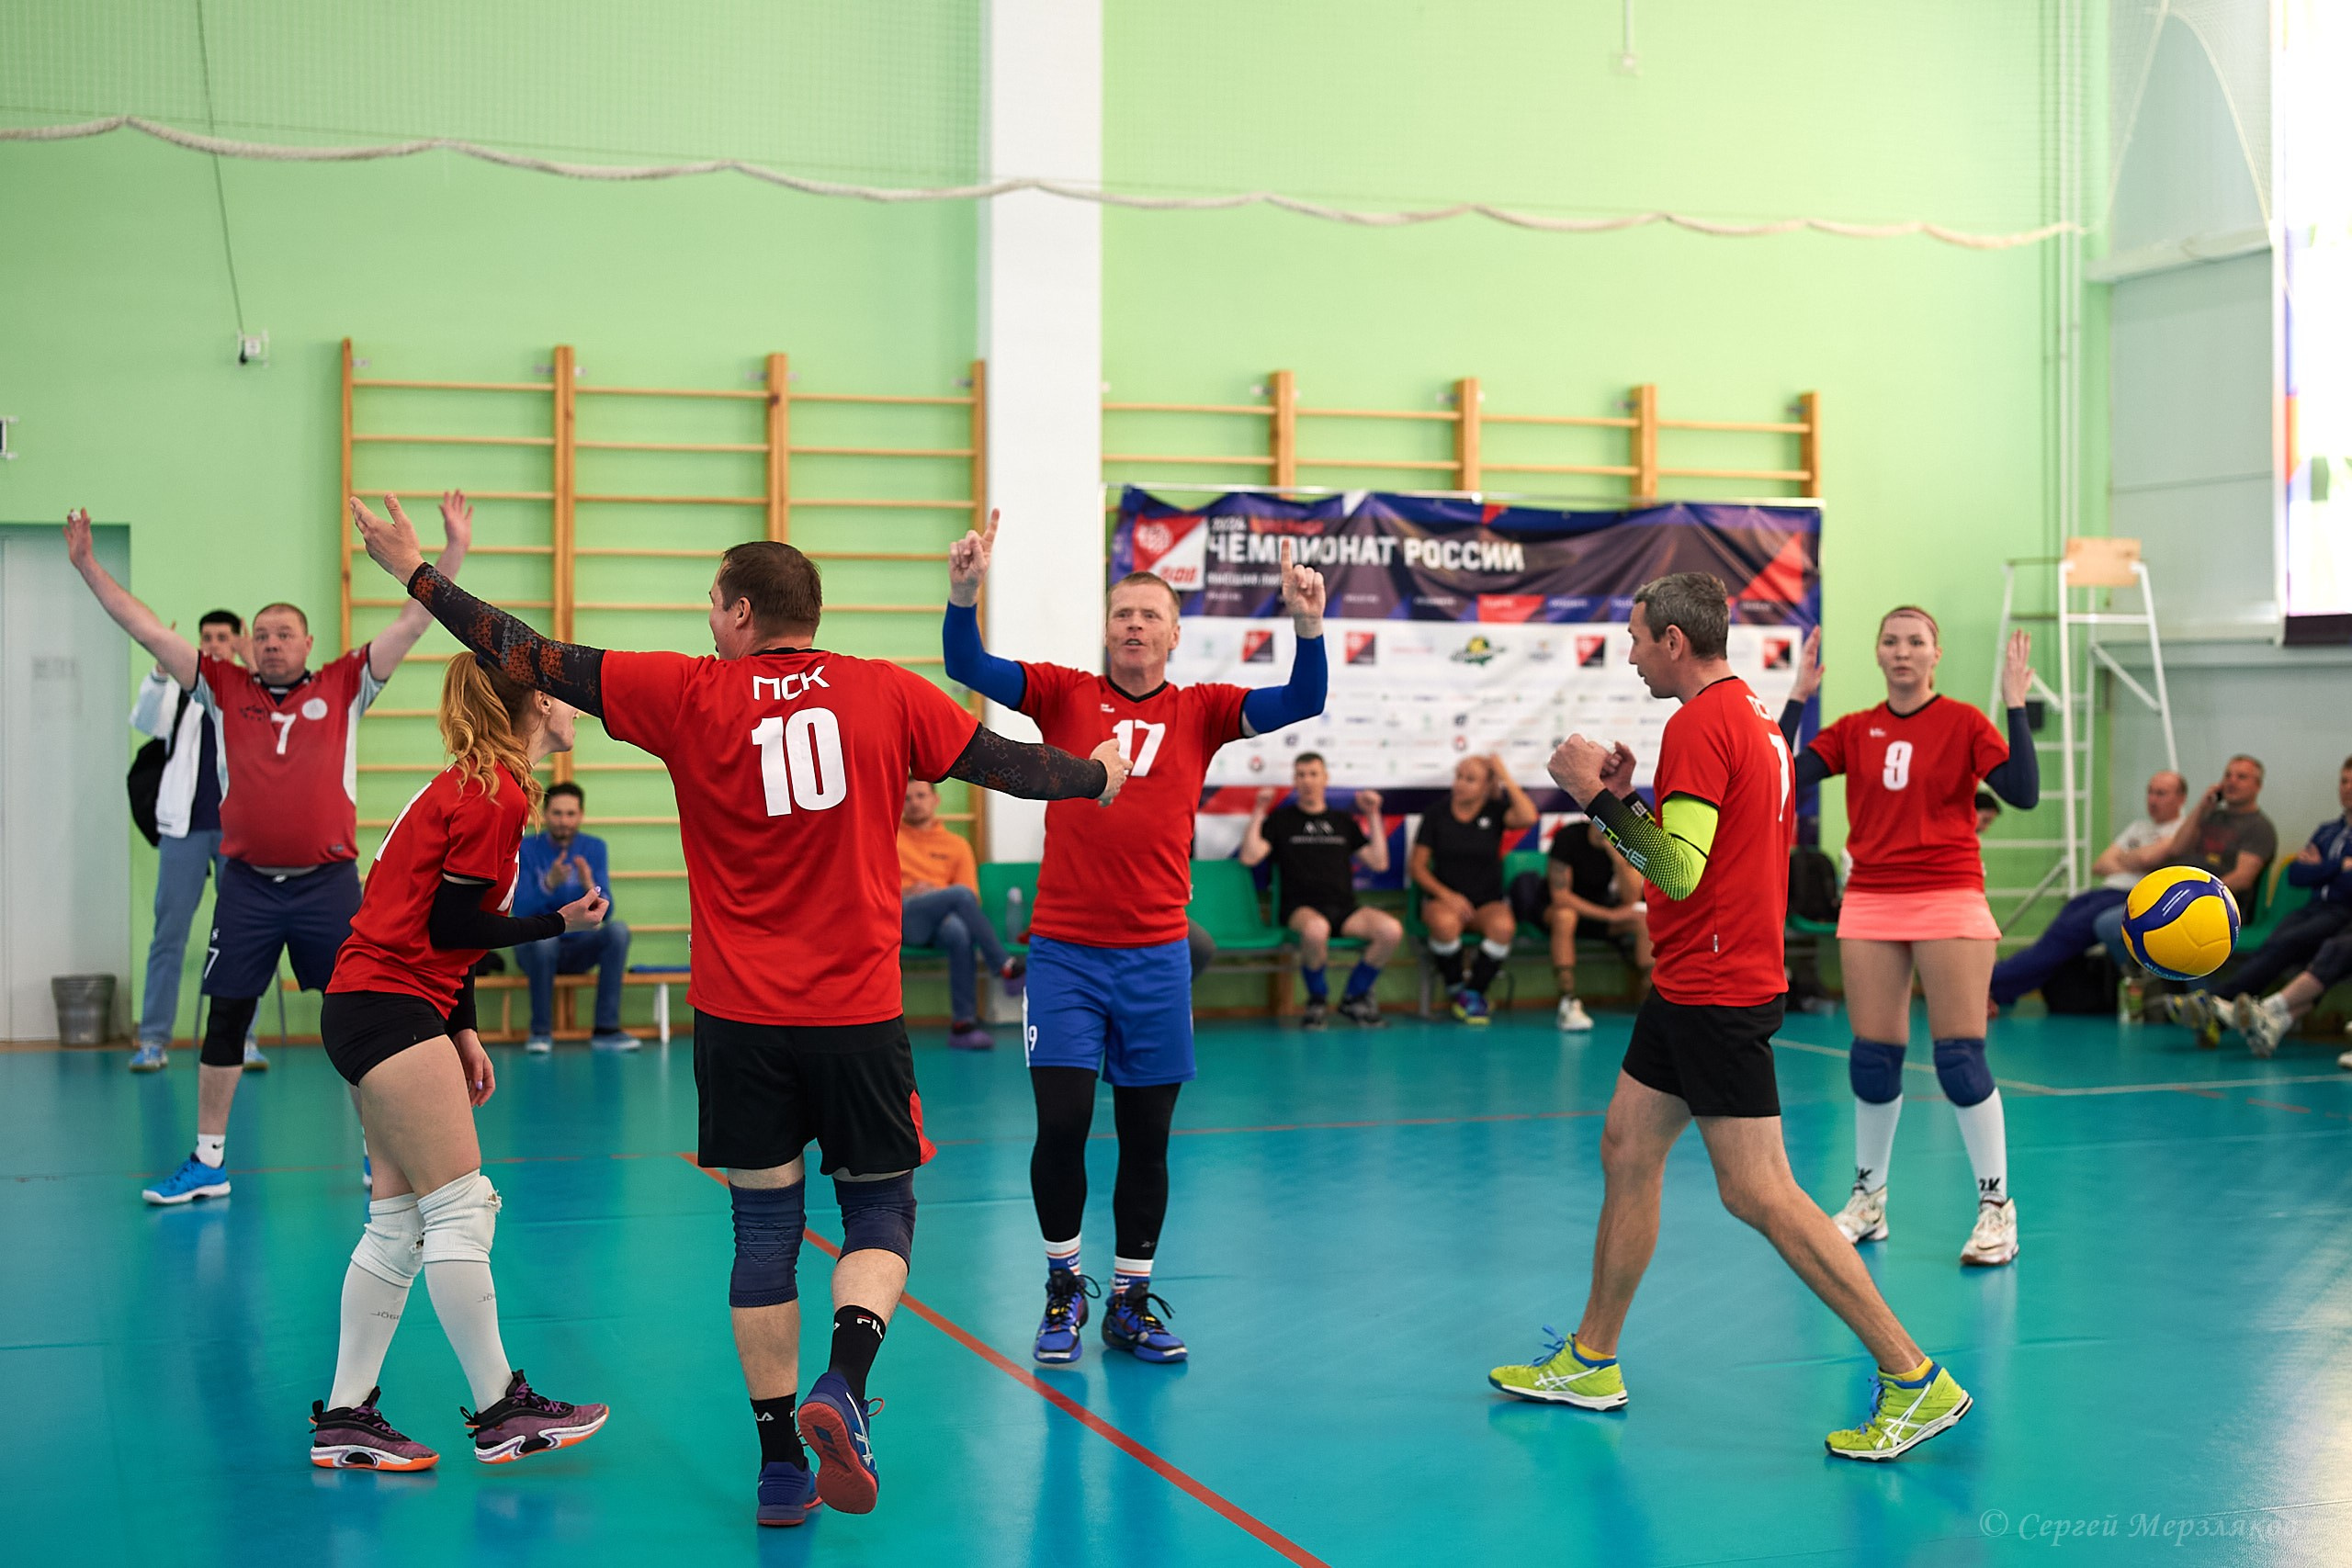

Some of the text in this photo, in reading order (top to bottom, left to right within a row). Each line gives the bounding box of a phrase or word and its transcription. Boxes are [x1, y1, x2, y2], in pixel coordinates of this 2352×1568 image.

[1208, 532, 1526, 571] ЧЕМПИОНАТ РОССИИ
[752, 665, 831, 701] ПСК
[1746, 694, 1774, 721] ПС
[270, 711, 297, 755] 7
[1112, 719, 1166, 777] 17
[752, 706, 847, 817] 10
[1883, 740, 1913, 791] 9
[204, 947, 220, 979] 7
[1028, 1024, 1038, 1051] 9
[856, 1314, 883, 1339] FIL
[754, 1412, 775, 1422] LA
